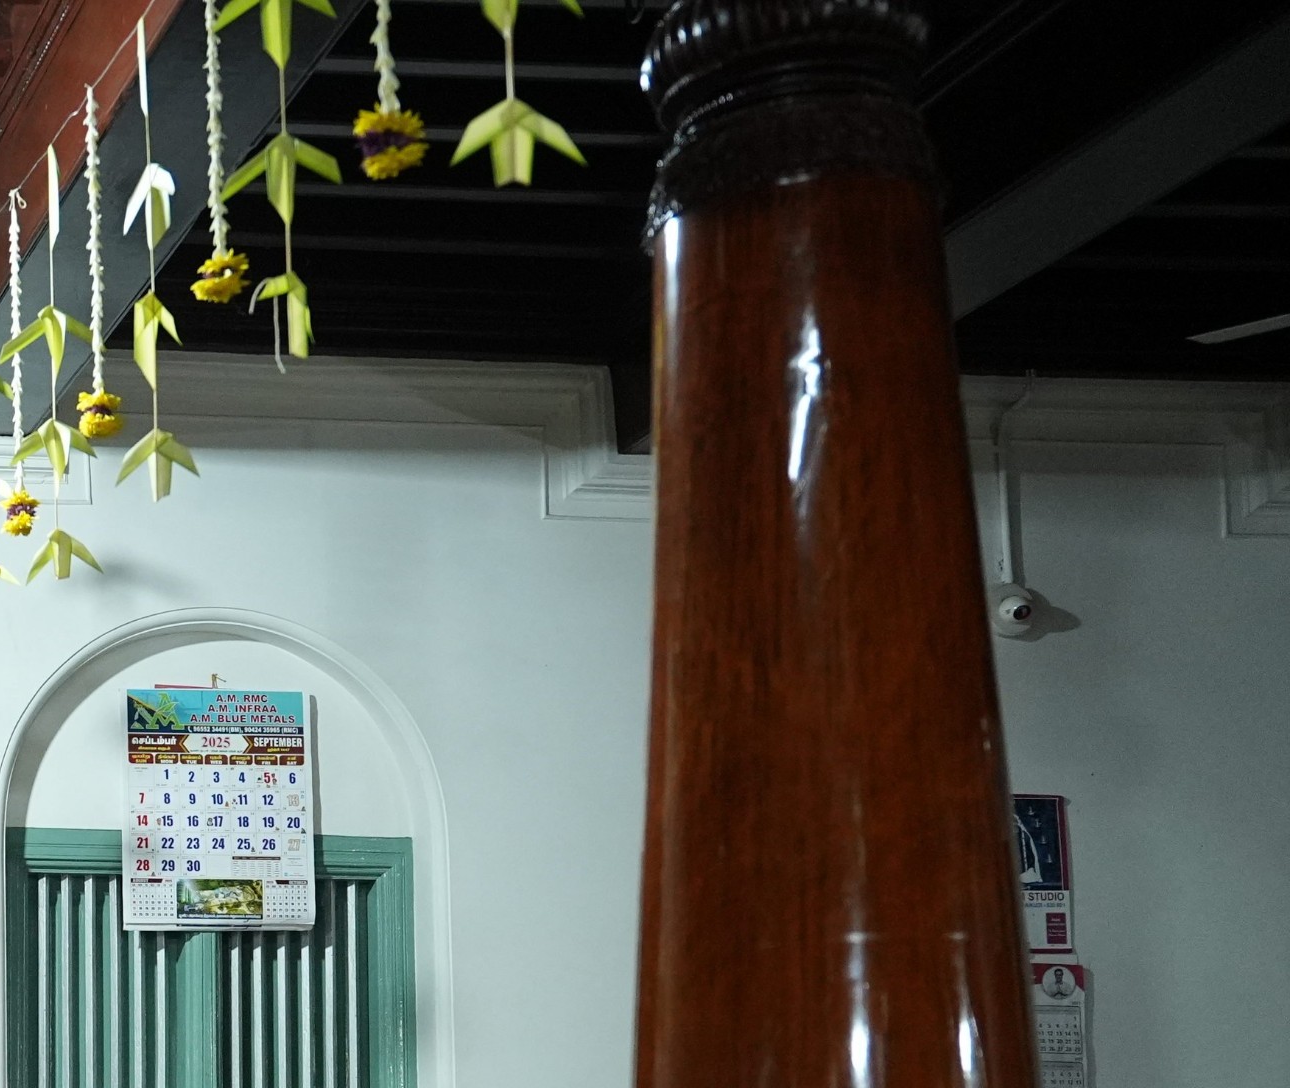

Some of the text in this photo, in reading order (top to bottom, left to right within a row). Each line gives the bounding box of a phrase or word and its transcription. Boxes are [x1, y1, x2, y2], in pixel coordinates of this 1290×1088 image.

[235, 705, 276, 713] INFRAA
[218, 715, 246, 723] BLUE
[251, 715, 295, 723] METALS
[201, 737, 230, 748] 2025
[254, 737, 302, 747] SEPTEMBER
[164, 769, 295, 784] 1 2 3 4 5 6
[139, 793, 144, 804] 7
[164, 793, 170, 804] 8
[189, 794, 195, 804] 9
[212, 794, 223, 804] 10
[238, 795, 247, 805] 11
[262, 795, 273, 805] 12
[137, 815, 300, 828] 14 15 16 17 18 19 20
[137, 838, 148, 848] 21
[162, 838, 174, 848] 22
[187, 838, 199, 849] 23
[212, 839, 224, 849] 24
[237, 839, 250, 849] 25
[262, 839, 275, 850] 26
[136, 860, 200, 871] 28 29 30
[1028, 892, 1064, 901] STUDIO
